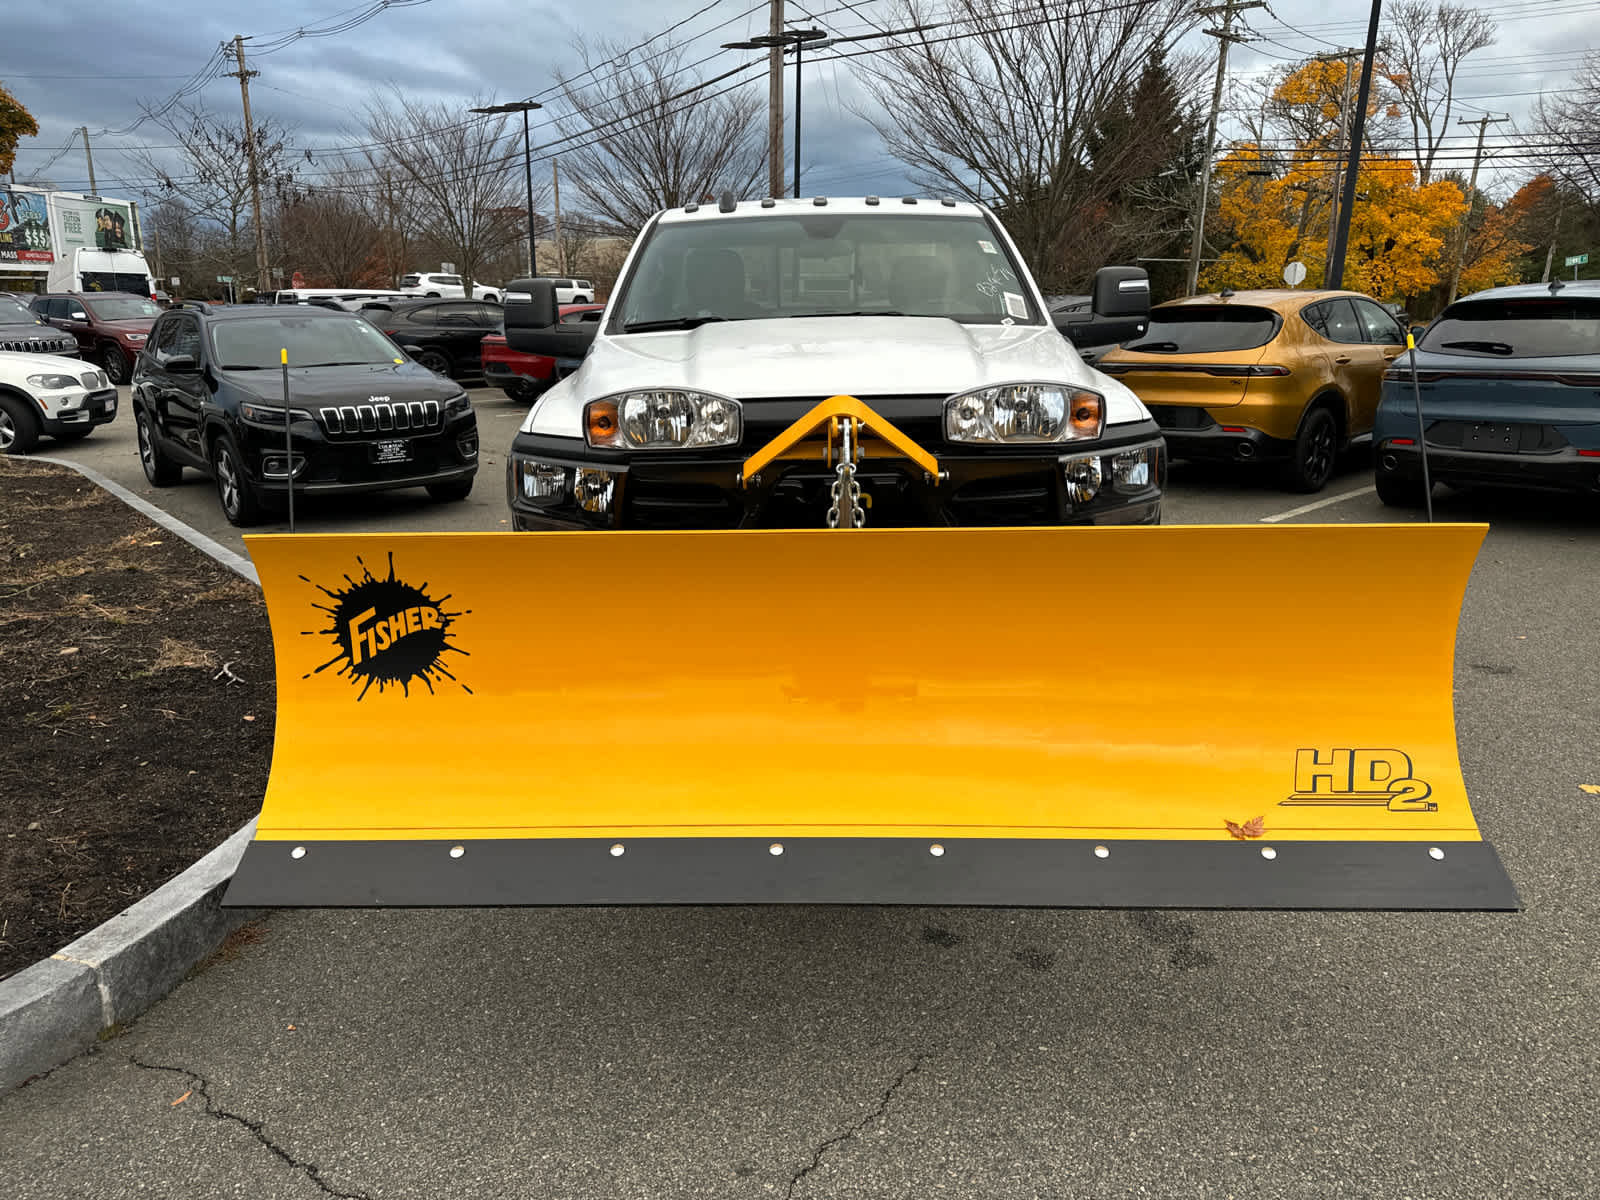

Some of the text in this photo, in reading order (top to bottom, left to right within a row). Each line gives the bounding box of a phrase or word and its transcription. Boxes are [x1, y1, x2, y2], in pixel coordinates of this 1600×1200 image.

[64, 222, 82, 233] FREE
[1, 250, 18, 259] MASS
[348, 606, 444, 666] FISHER
